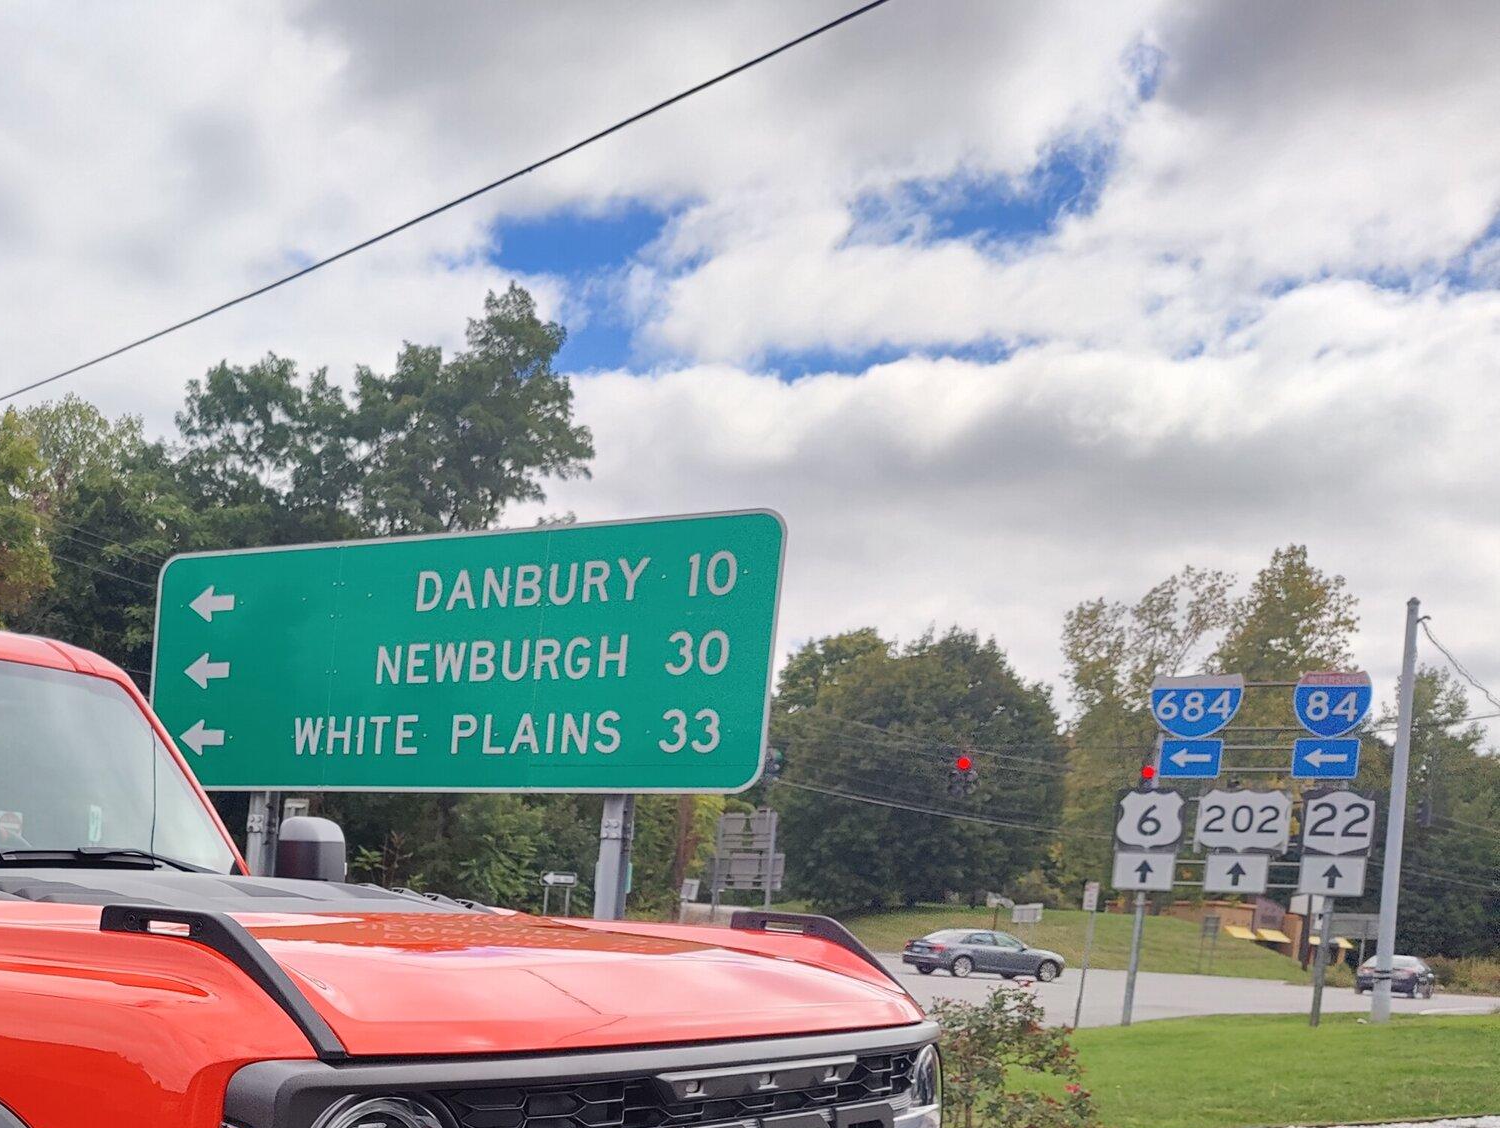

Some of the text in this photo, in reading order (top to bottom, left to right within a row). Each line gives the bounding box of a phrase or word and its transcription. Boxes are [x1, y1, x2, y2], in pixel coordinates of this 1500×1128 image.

[415, 551, 737, 612] DANBURY 10
[375, 630, 729, 684] NEWBURGH 30
[1156, 690, 1232, 722] 684
[1305, 690, 1357, 722] 84
[294, 709, 720, 755] WHITE PLAINS 33
[1137, 804, 1161, 836] 6
[1203, 804, 1280, 834] 202
[1308, 802, 1370, 838] 22
